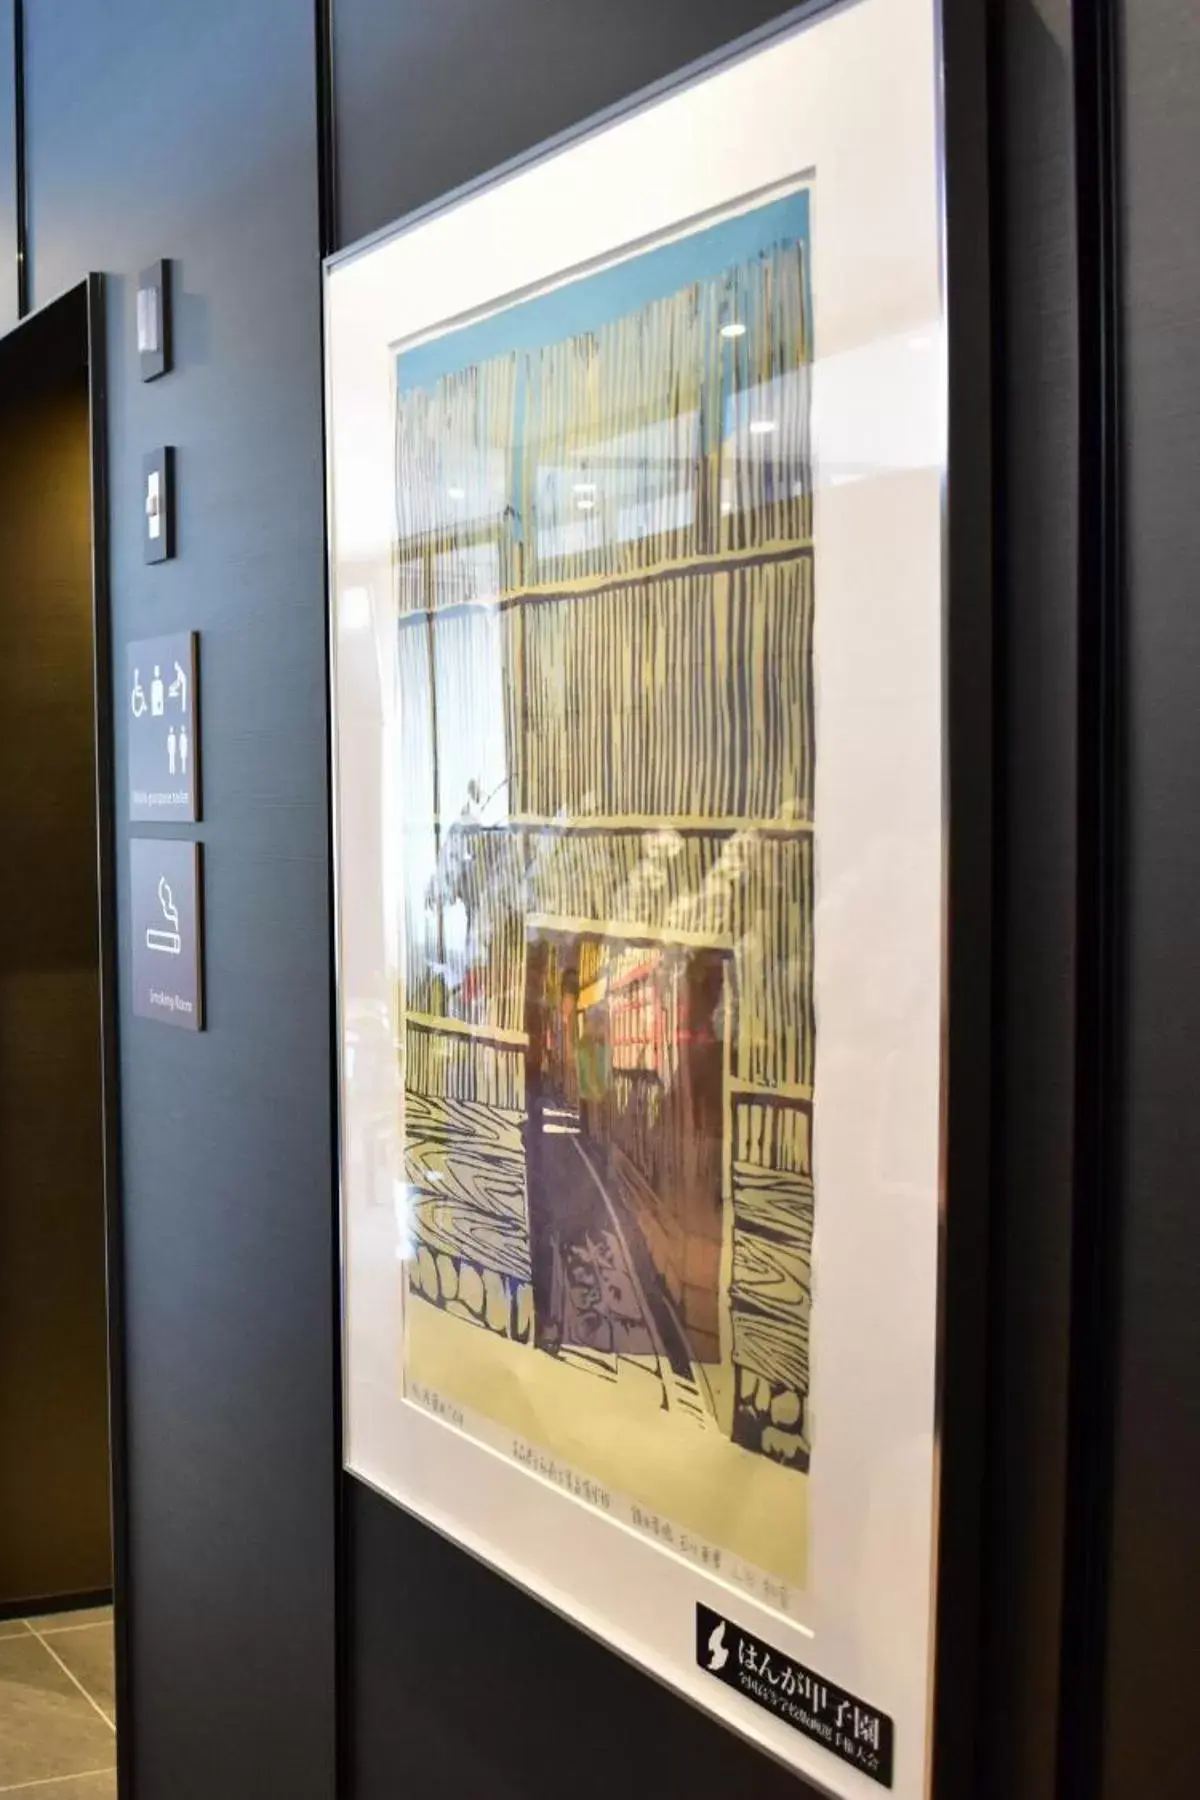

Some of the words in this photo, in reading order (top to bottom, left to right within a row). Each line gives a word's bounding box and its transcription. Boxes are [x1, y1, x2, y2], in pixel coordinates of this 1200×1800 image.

[738, 1637, 880, 1751] はんが甲子園
